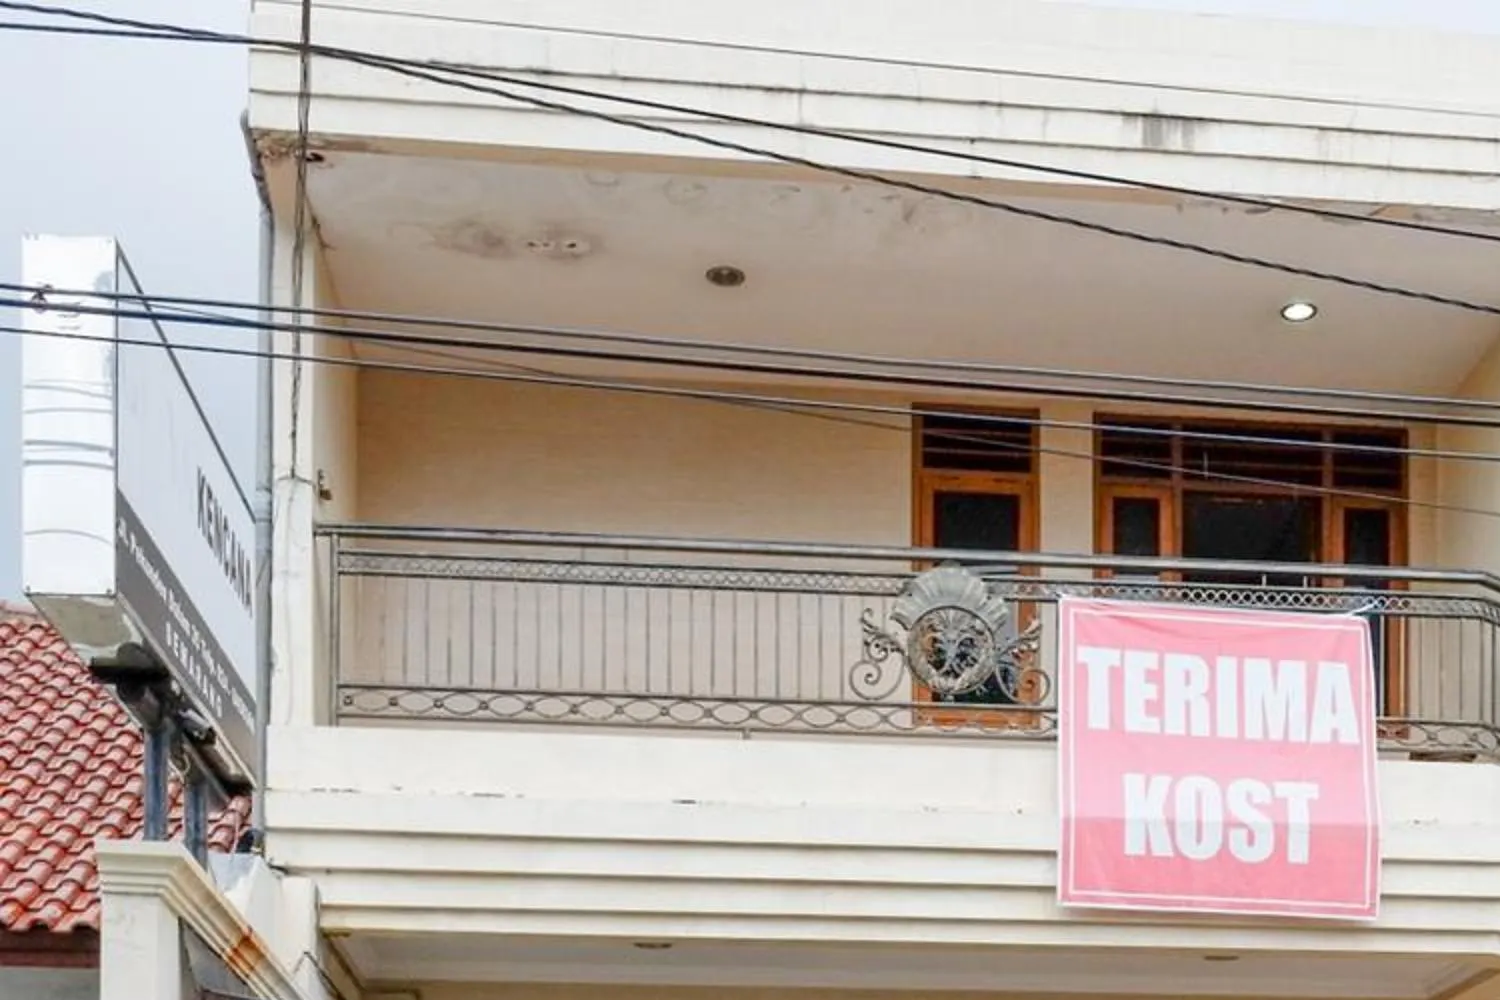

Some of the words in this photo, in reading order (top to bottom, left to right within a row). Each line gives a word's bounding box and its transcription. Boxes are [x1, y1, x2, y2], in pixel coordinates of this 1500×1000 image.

[197, 464, 253, 619] KENCANA
[1077, 645, 1360, 744] TERIMA
[1122, 773, 1320, 865] KOST
